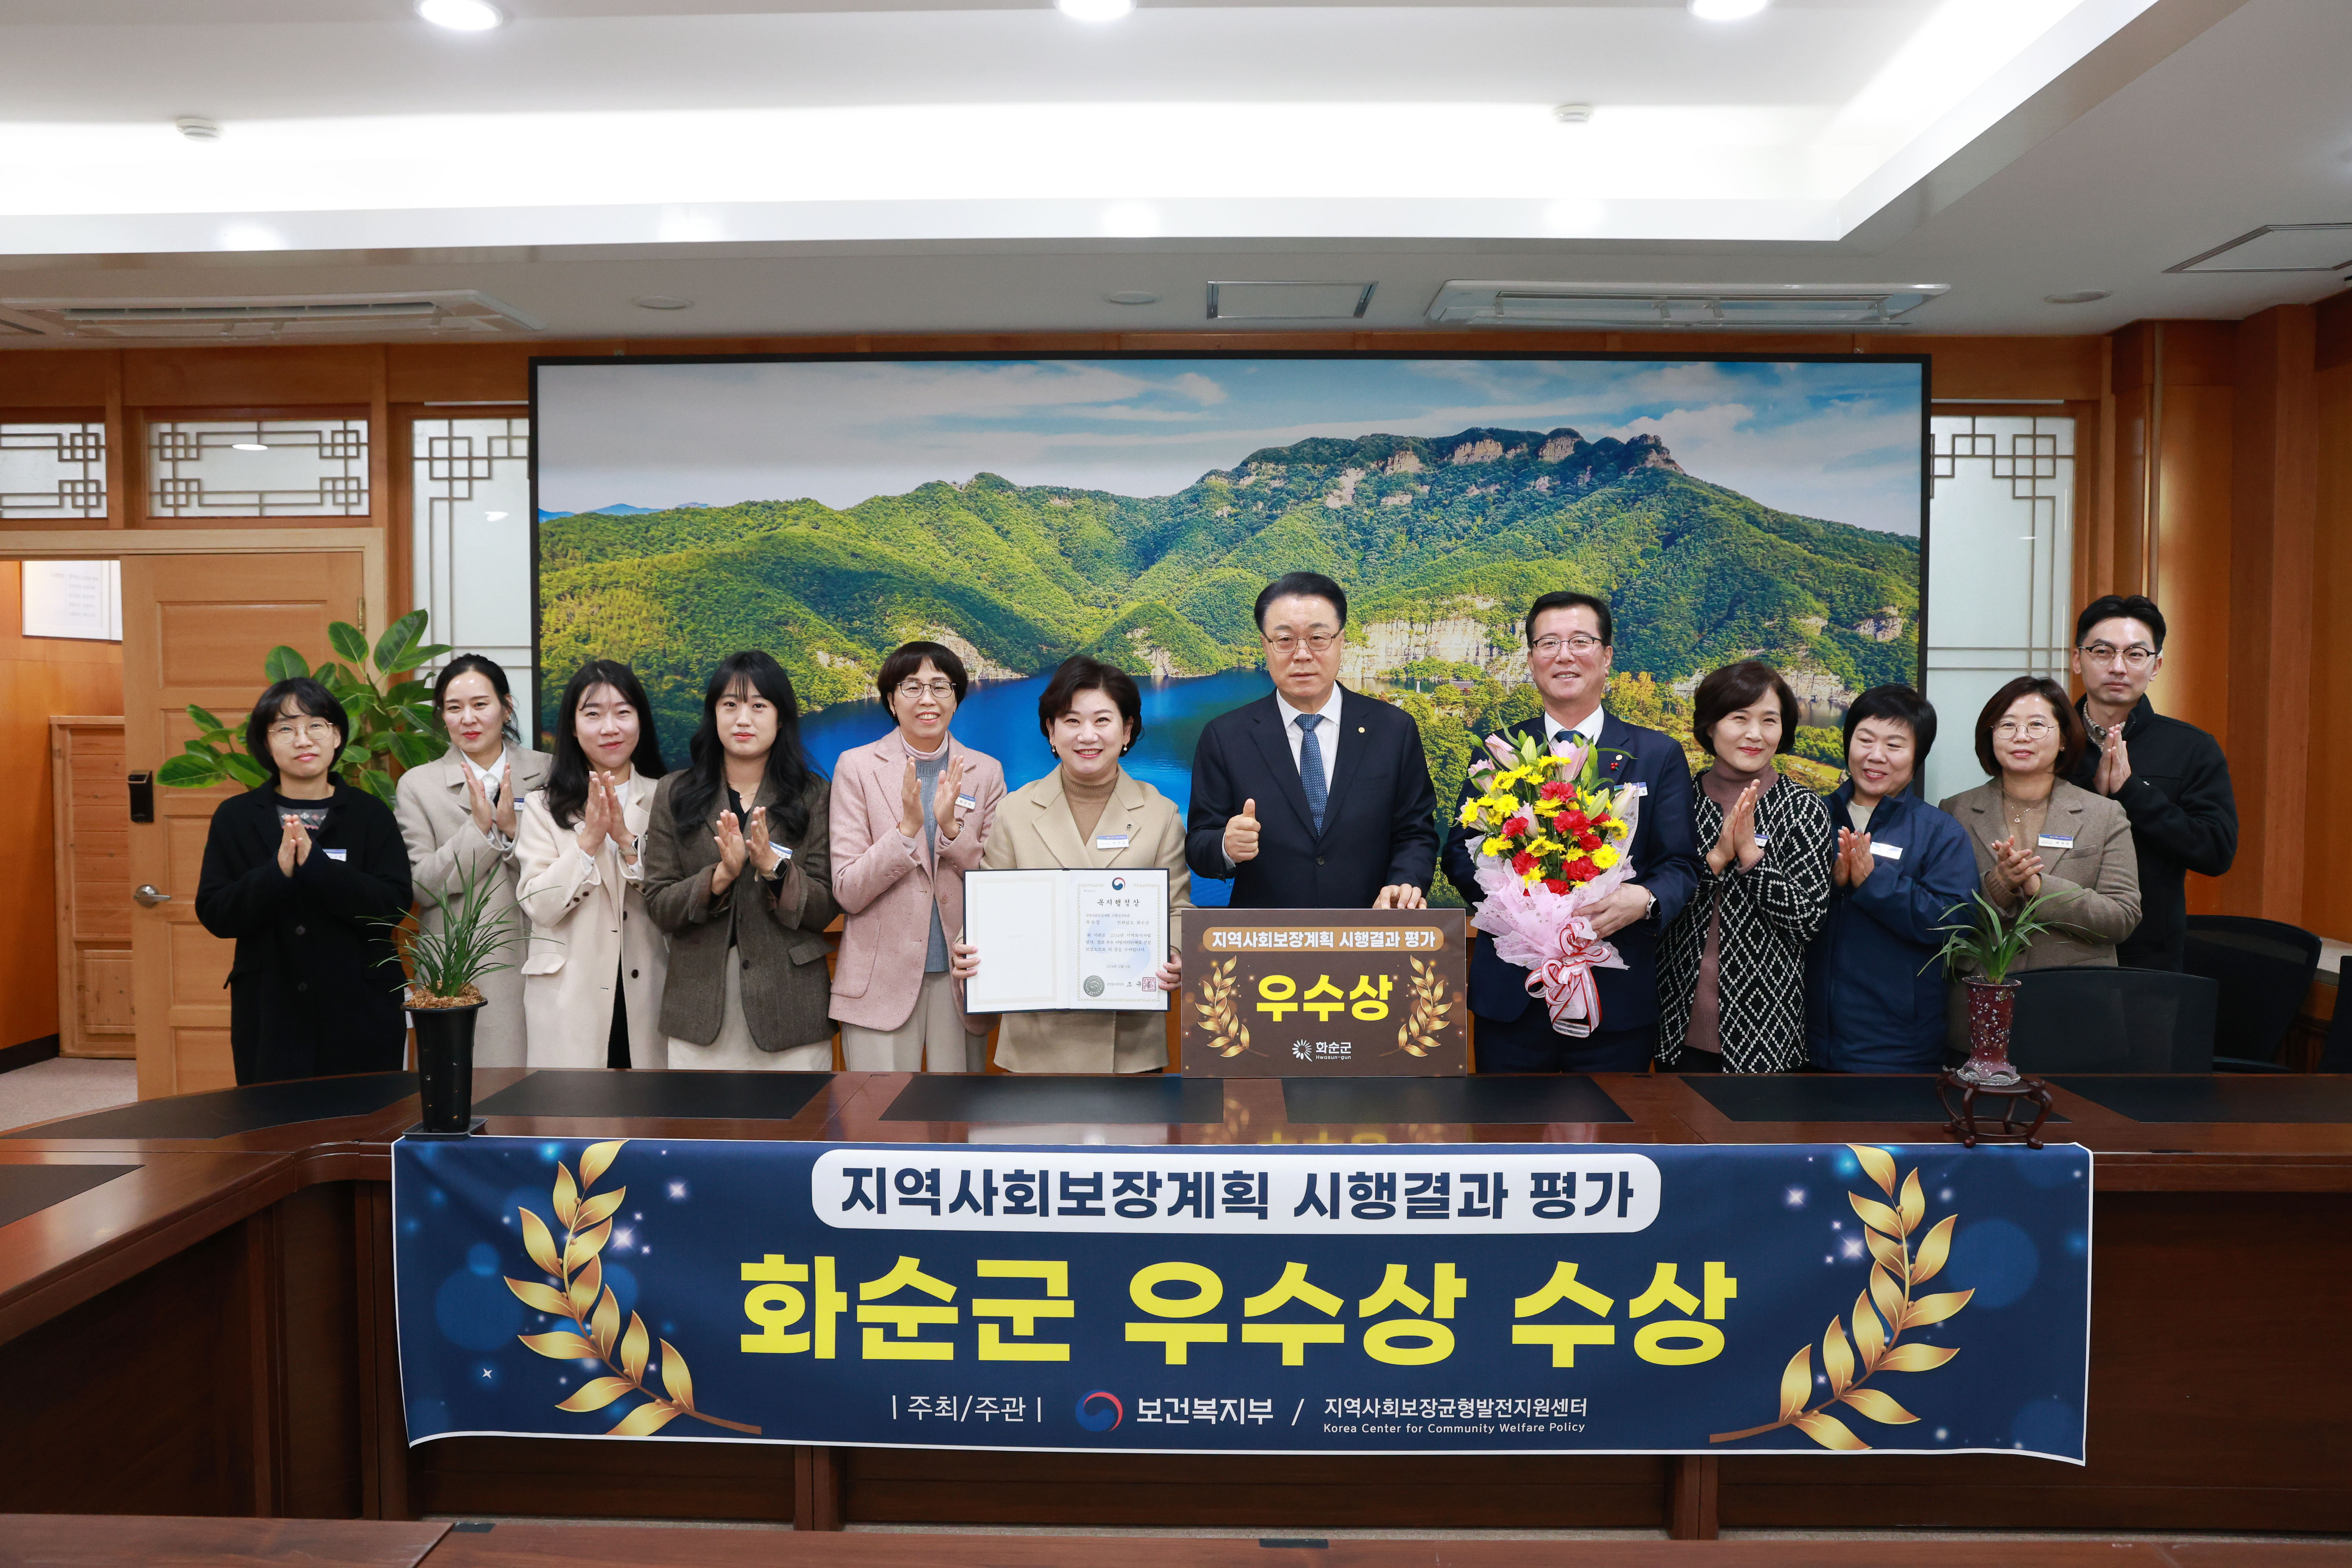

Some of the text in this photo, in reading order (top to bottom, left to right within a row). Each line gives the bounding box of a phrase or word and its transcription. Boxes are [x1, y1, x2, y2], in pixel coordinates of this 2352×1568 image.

[1212, 931, 1436, 948] 지역사회보장계획 시행결과 평가
[1256, 975, 1393, 1022] 우수상
[1316, 1042, 1352, 1054] 화순군
[842, 1167, 1634, 1220] 지역사회보장계획 시행결과 평가
[740, 1254, 1737, 1368] 화순군 우수상 수상
[908, 1396, 1026, 1422] 주최/주관
[1137, 1397, 1273, 1425] 보건복지부
[1324, 1398, 1587, 1419] 지역사회보장균형발전지원센터
[1324, 1422, 1585, 1434] Korea Center for Community Welfare Policy
